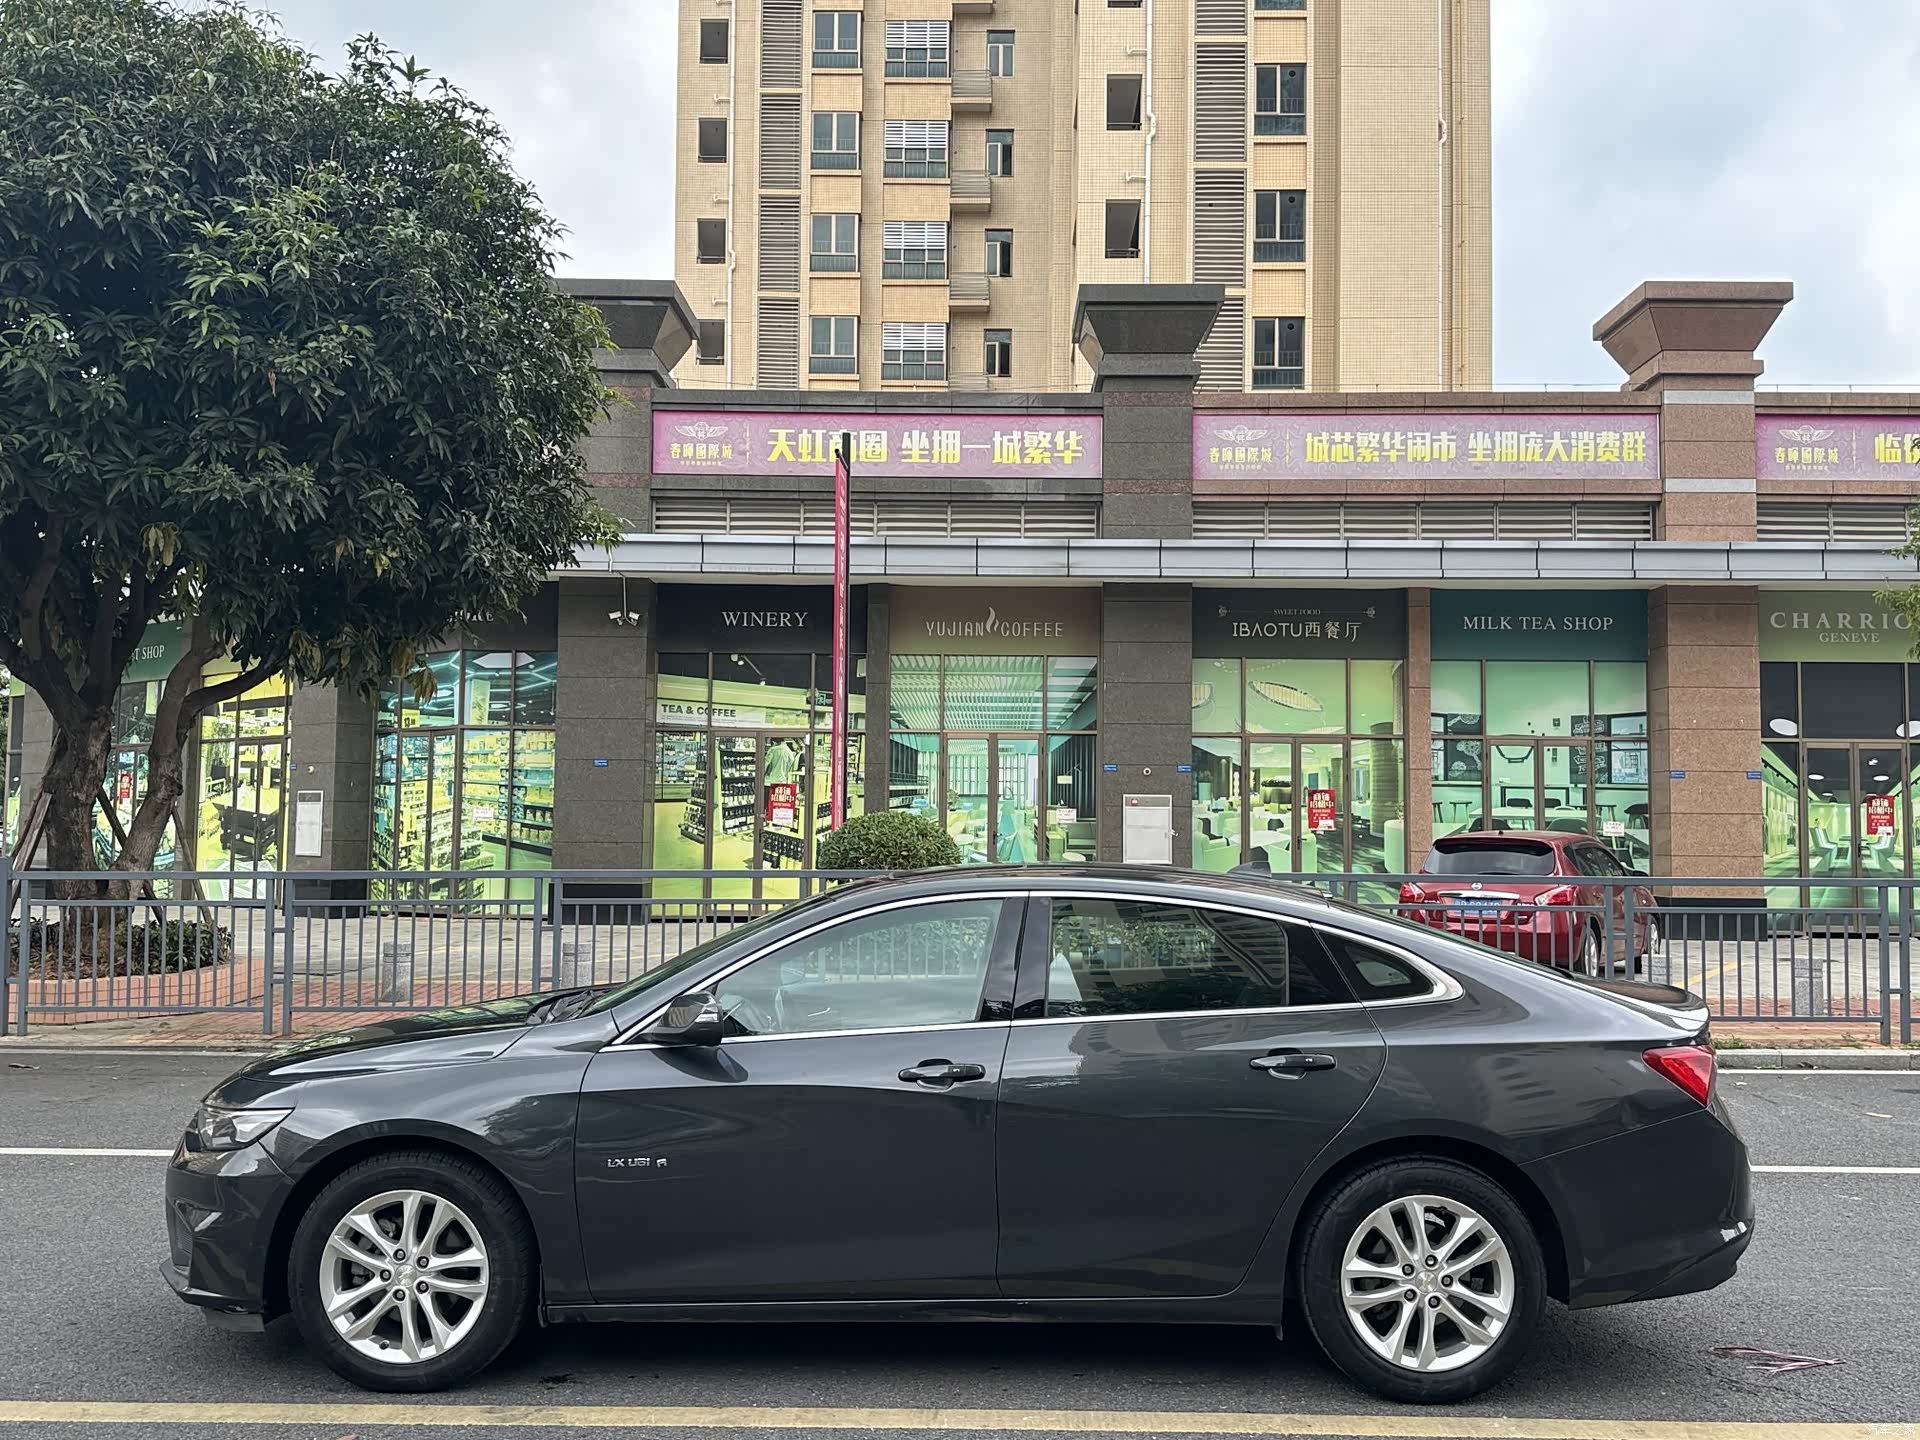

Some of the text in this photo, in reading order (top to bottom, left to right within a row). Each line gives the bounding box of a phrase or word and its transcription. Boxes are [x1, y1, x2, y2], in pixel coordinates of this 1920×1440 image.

[767, 428, 1083, 464] 天虹商圈 坐拥一城繁华
[1305, 430, 1646, 463] 城芯繁华闹市 坐拥庞大消费群
[721, 611, 808, 627] WINERY
[1273, 608, 1321, 616] SWEET FOOD
[926, 621, 1064, 637] YUJIAN COFFEE
[1463, 616, 1614, 631] MILK TEA SHOP
[1819, 632, 1881, 643] GENEVE
[141, 644, 165, 660] SHOP
[661, 703, 737, 718] TEA & COFFEE
